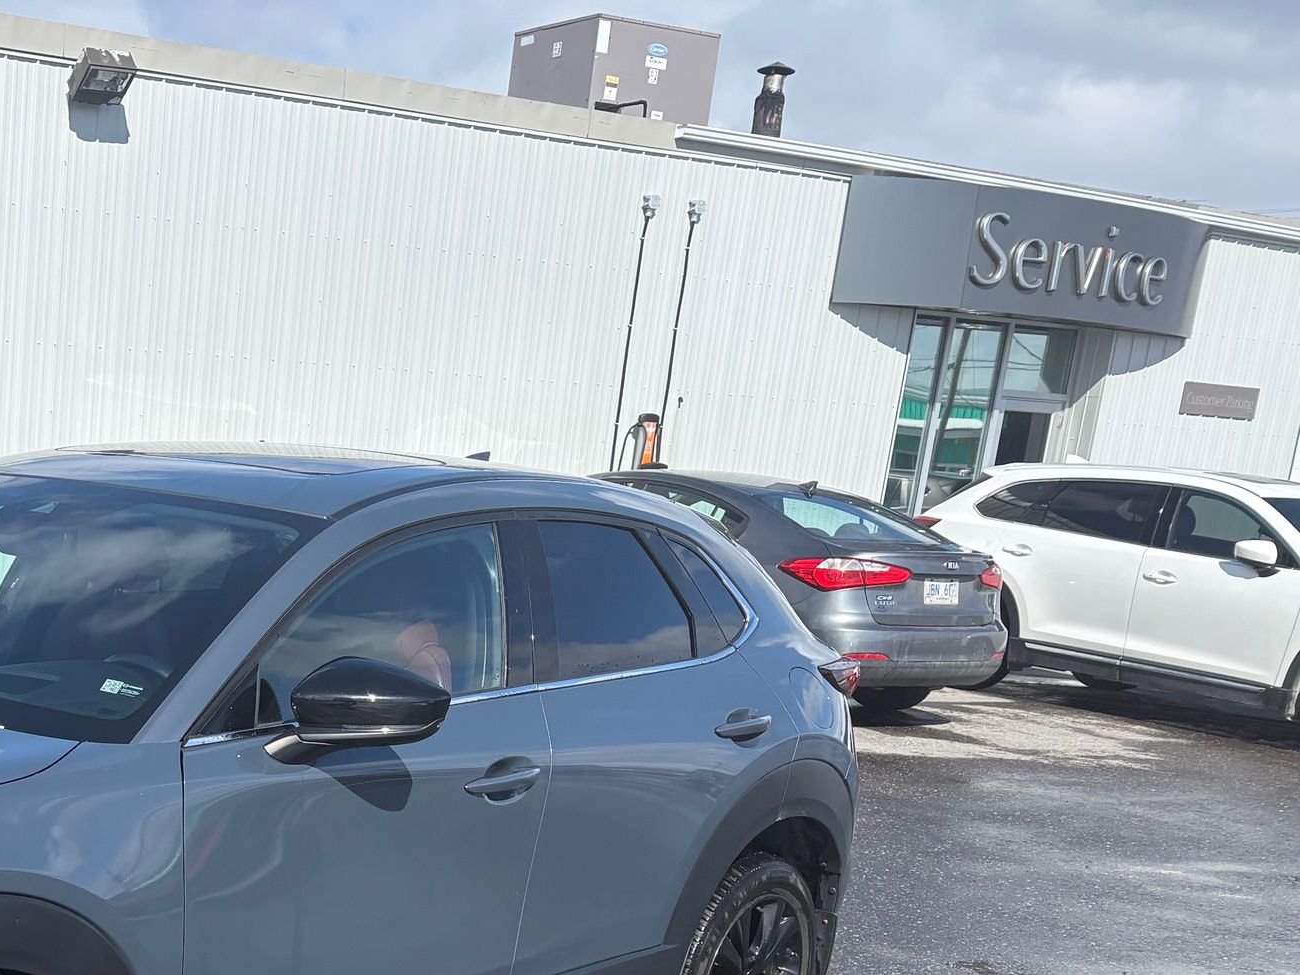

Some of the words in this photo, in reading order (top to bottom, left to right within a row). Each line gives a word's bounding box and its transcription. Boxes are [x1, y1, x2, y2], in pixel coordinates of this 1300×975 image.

[969, 212, 1168, 305] Service
[1186, 391, 1226, 408] Customer
[1227, 395, 1254, 413] Parking
[947, 561, 960, 570] KIA
